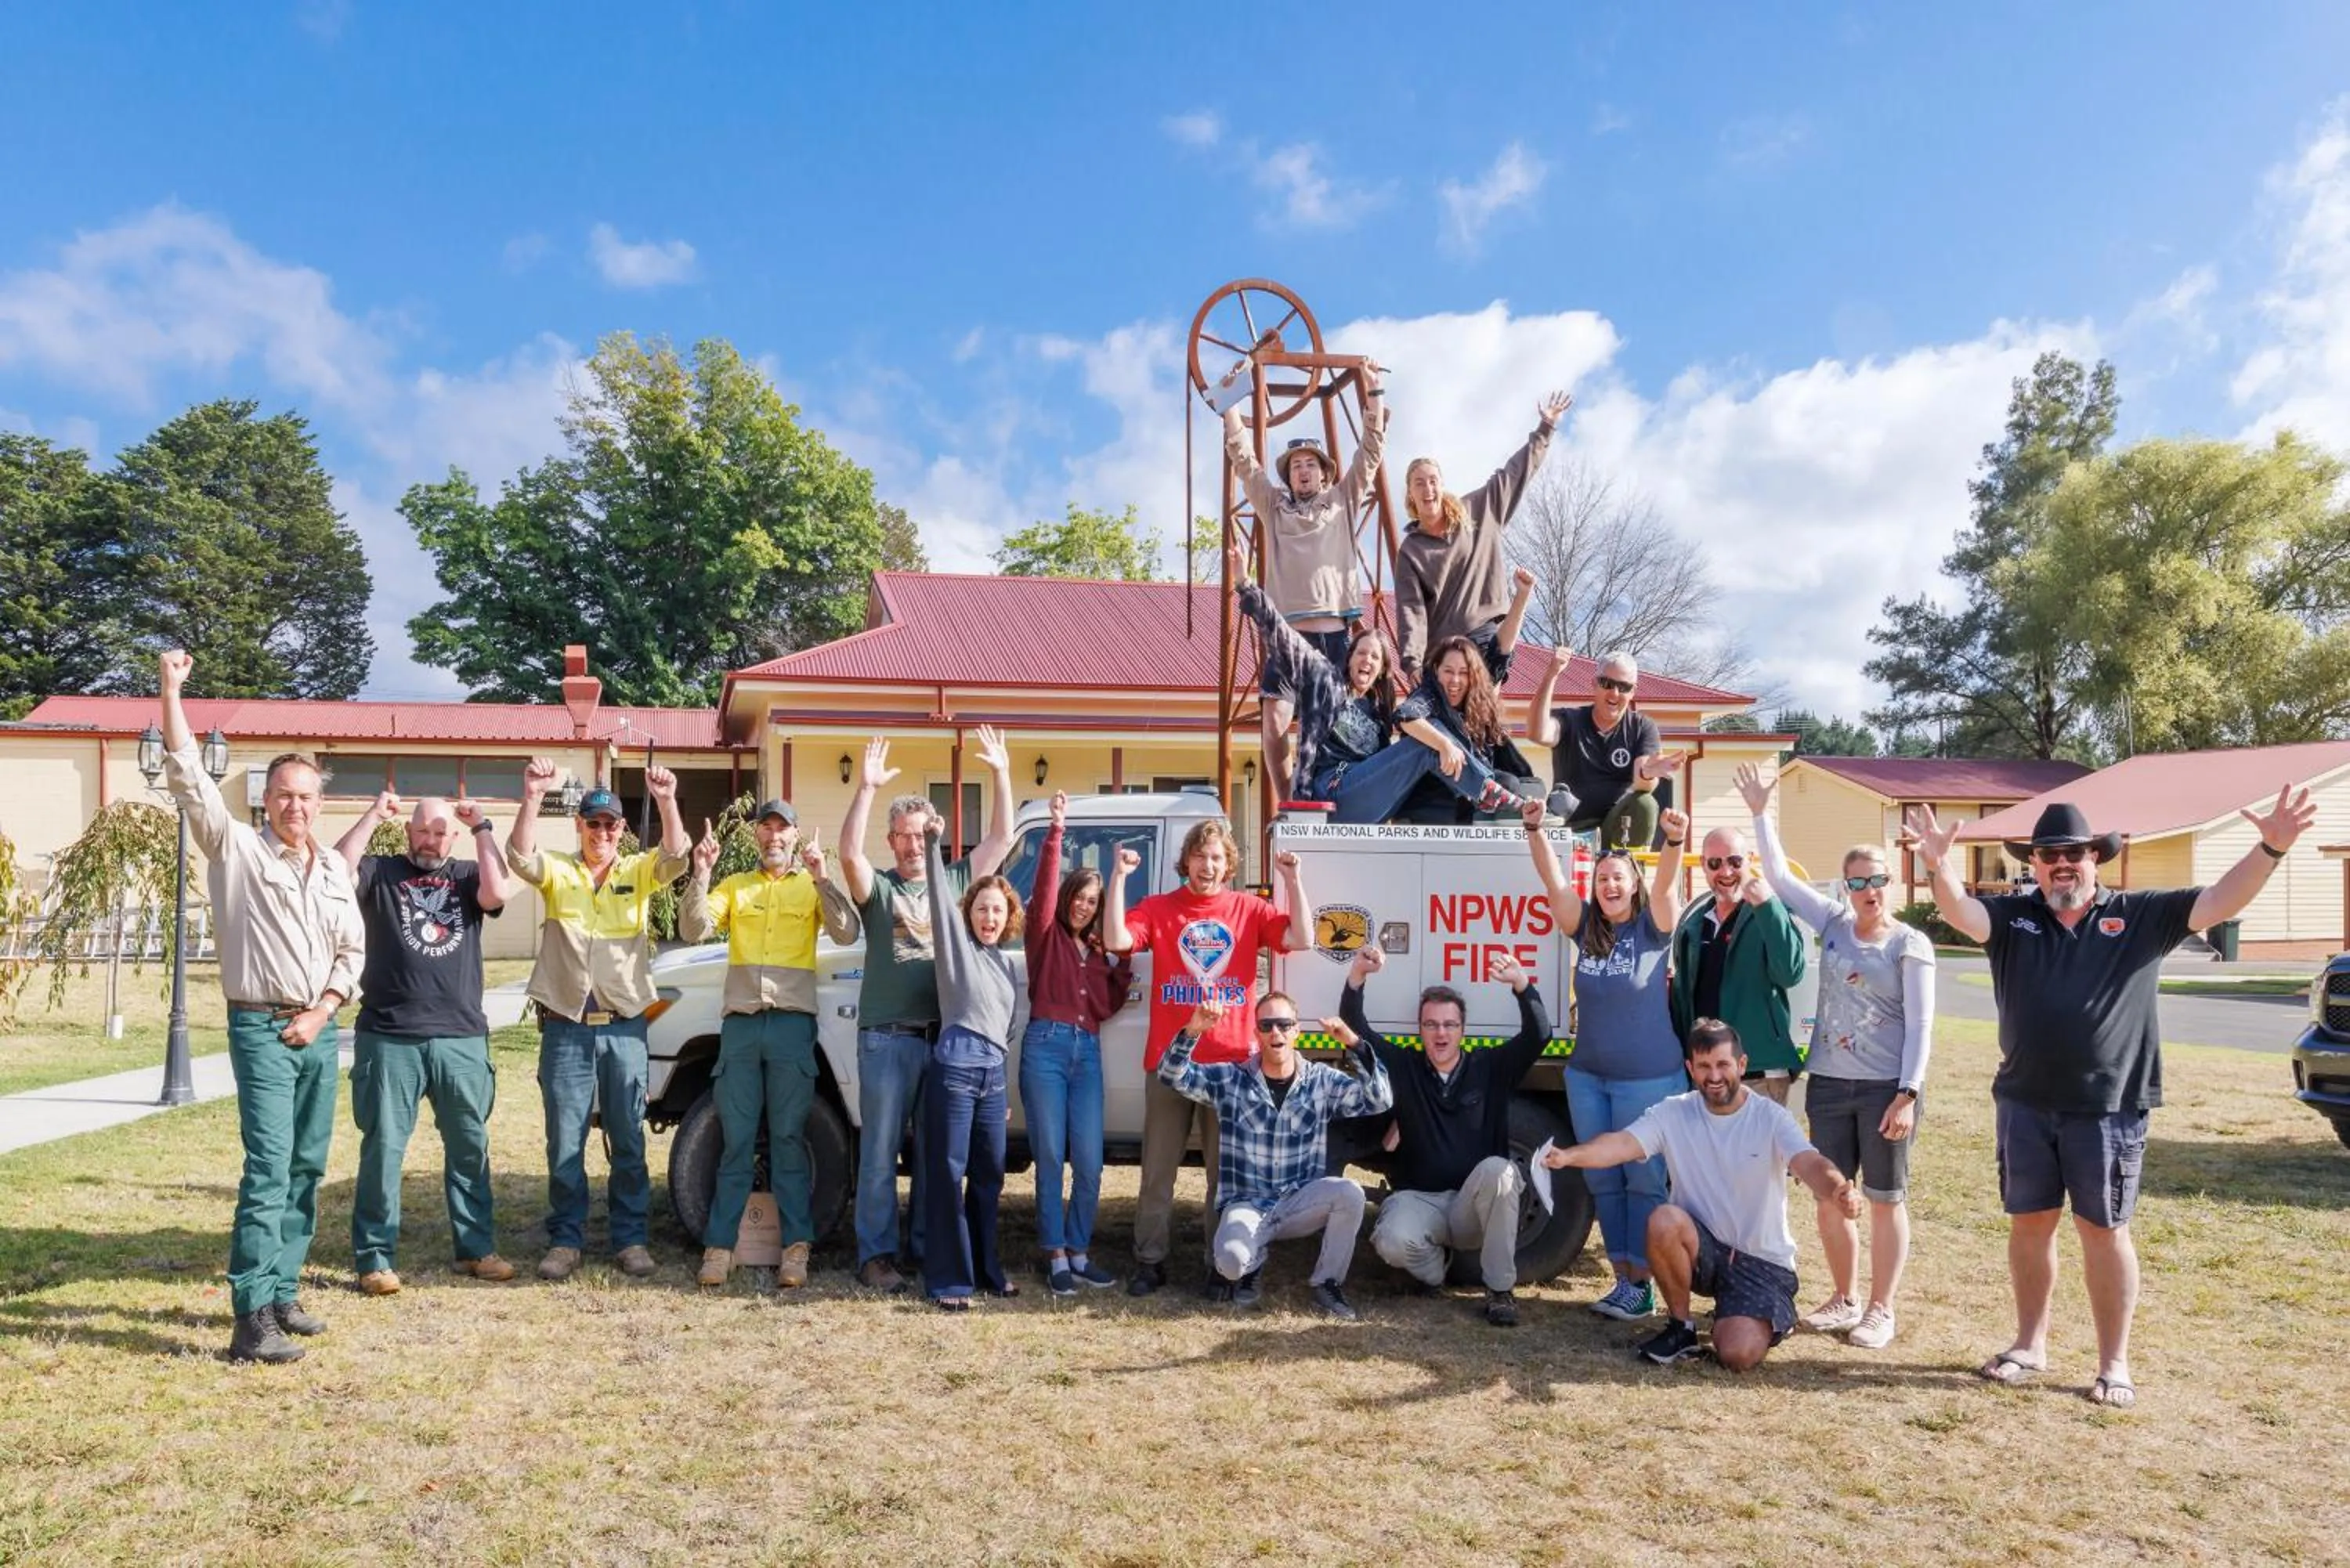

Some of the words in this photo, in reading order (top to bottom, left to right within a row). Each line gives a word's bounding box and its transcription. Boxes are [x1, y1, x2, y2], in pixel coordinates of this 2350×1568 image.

[1281, 825, 1309, 836] NSW
[1312, 825, 1374, 837] NATIONAL
[1378, 826, 1419, 838] PARKS
[1423, 828, 1449, 839] AND
[1453, 828, 1511, 840] WILDLIFE
[1514, 829, 1567, 840] SEICE
[401, 905, 421, 951] SUPERIOR
[422, 906, 465, 957] PERFORMANCE
[1430, 894, 1553, 936] NPWS
